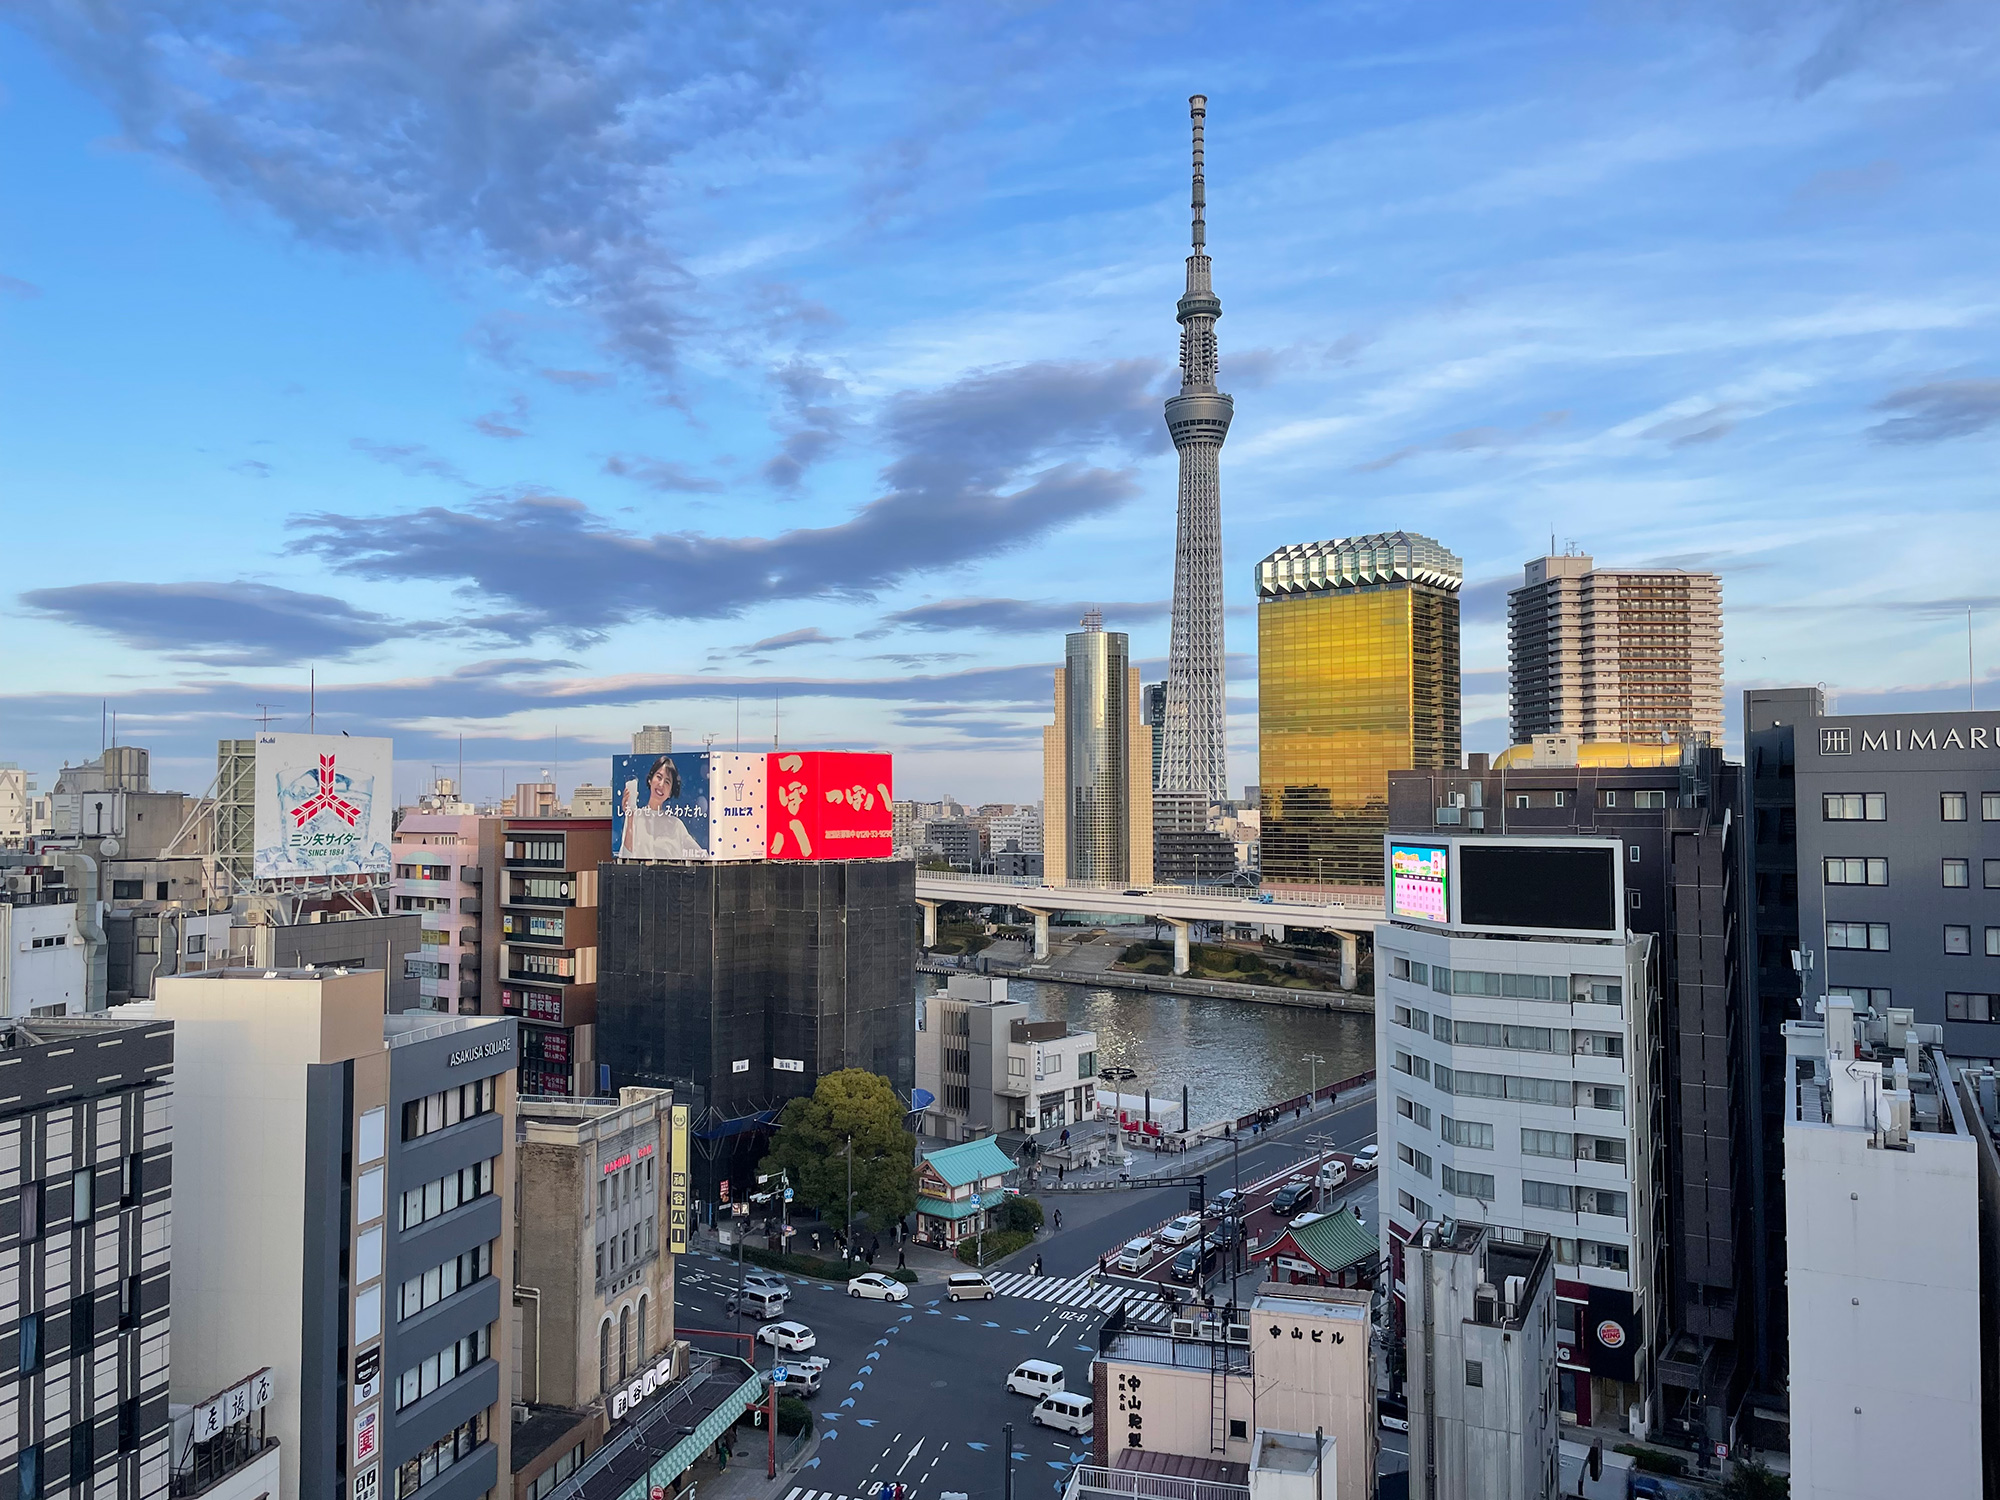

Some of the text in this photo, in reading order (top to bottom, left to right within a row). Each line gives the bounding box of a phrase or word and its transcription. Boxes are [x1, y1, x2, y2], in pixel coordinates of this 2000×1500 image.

[1861, 727, 2000, 751] MIMAR
[617, 804, 708, 818] しあわせ、しみわたれ。
[723, 806, 753, 817] カルピス
[289, 833, 362, 847] 三ツ矢サイダー
[308, 848, 345, 857] SINCE 1884
[450, 1037, 511, 1067] ASAKUSA SQUARE
[604, 1144, 653, 1175] KAMIYA BAR
[672, 1172, 685, 1243] 神谷バー
[1269, 1324, 1345, 1345] 中山ビル
[618, 1368, 669, 1415] 神谷バー
[359, 1428, 374, 1456] 薬
